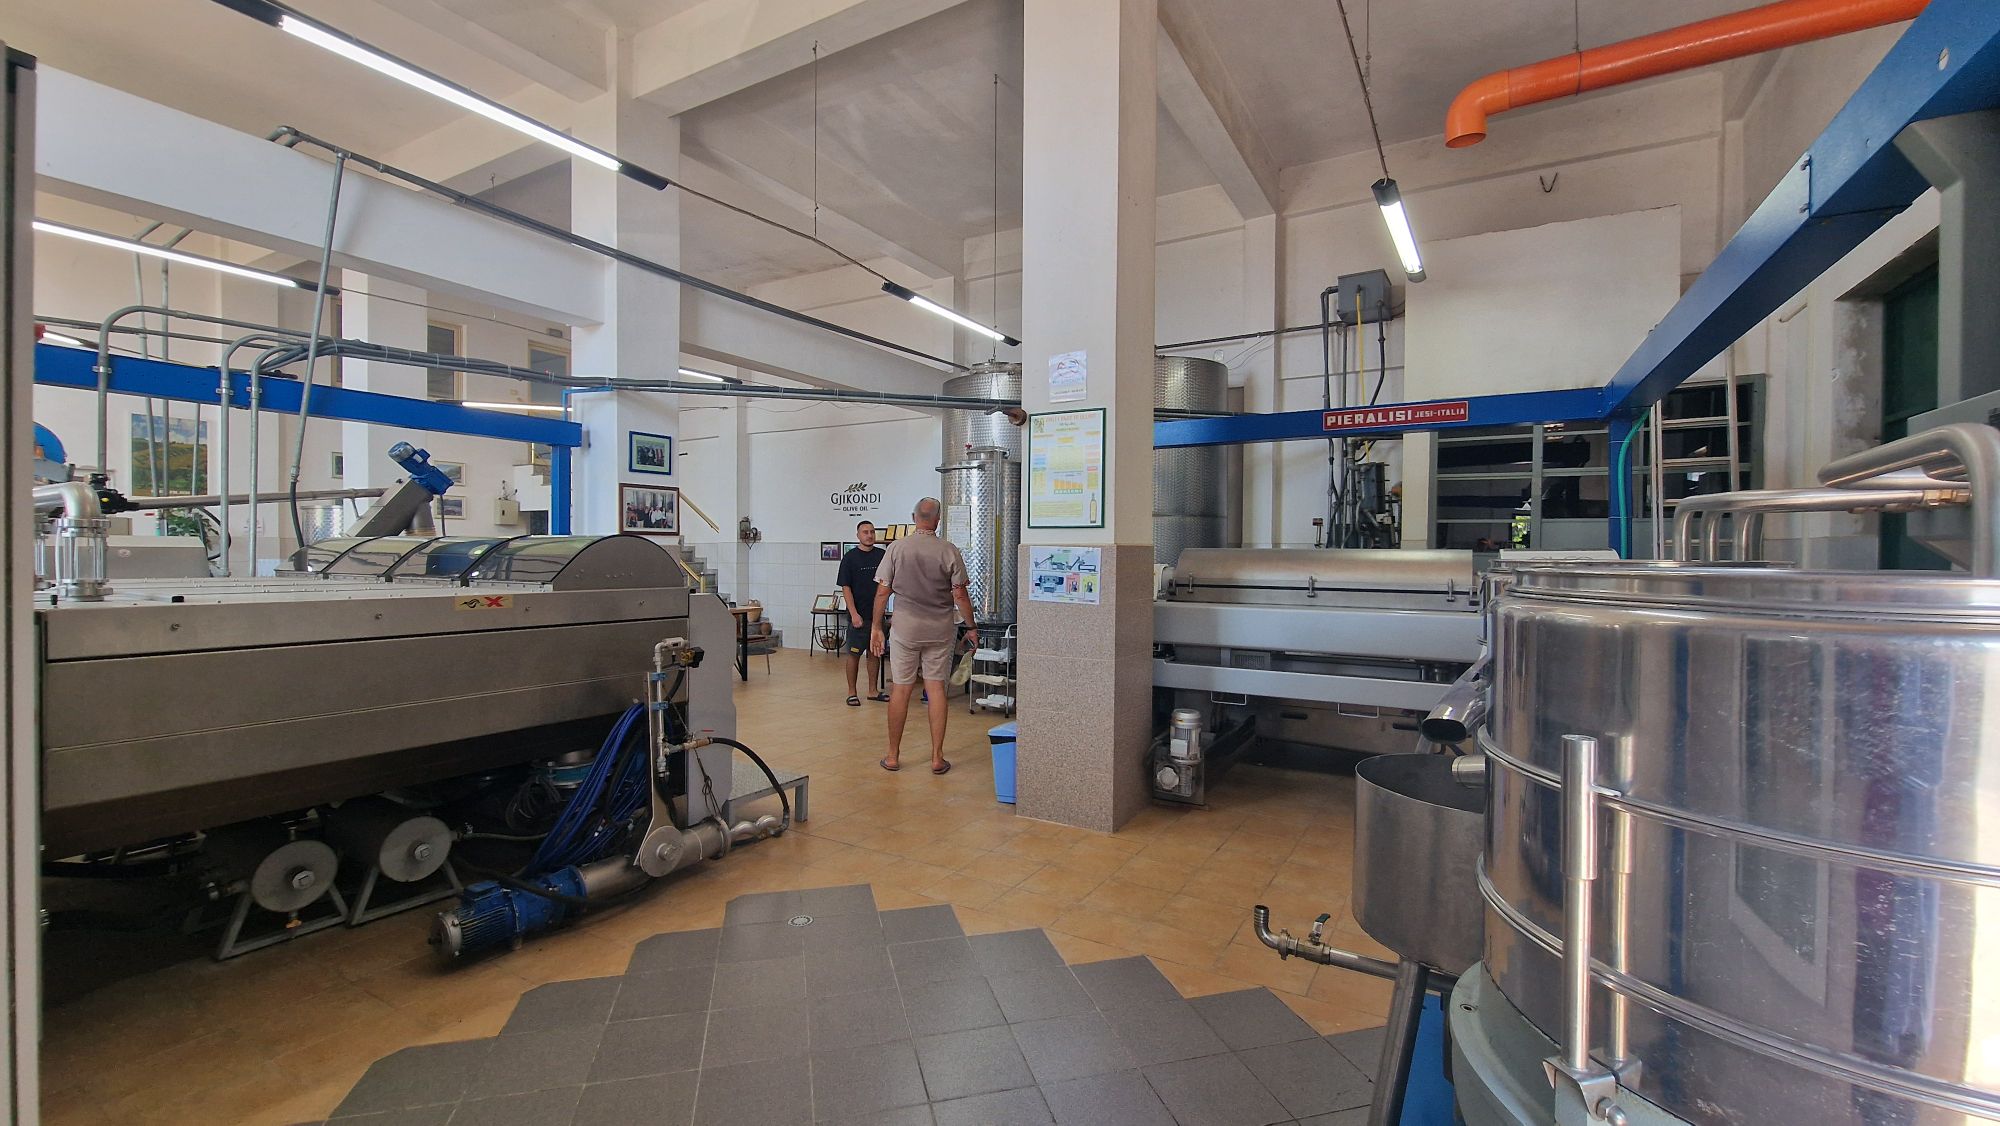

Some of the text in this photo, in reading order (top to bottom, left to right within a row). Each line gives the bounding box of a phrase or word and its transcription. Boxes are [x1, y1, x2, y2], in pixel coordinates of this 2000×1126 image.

[1326, 408, 1465, 427] PIERALISI JESI-ITALIA
[830, 492, 881, 506] GJIKONDI
